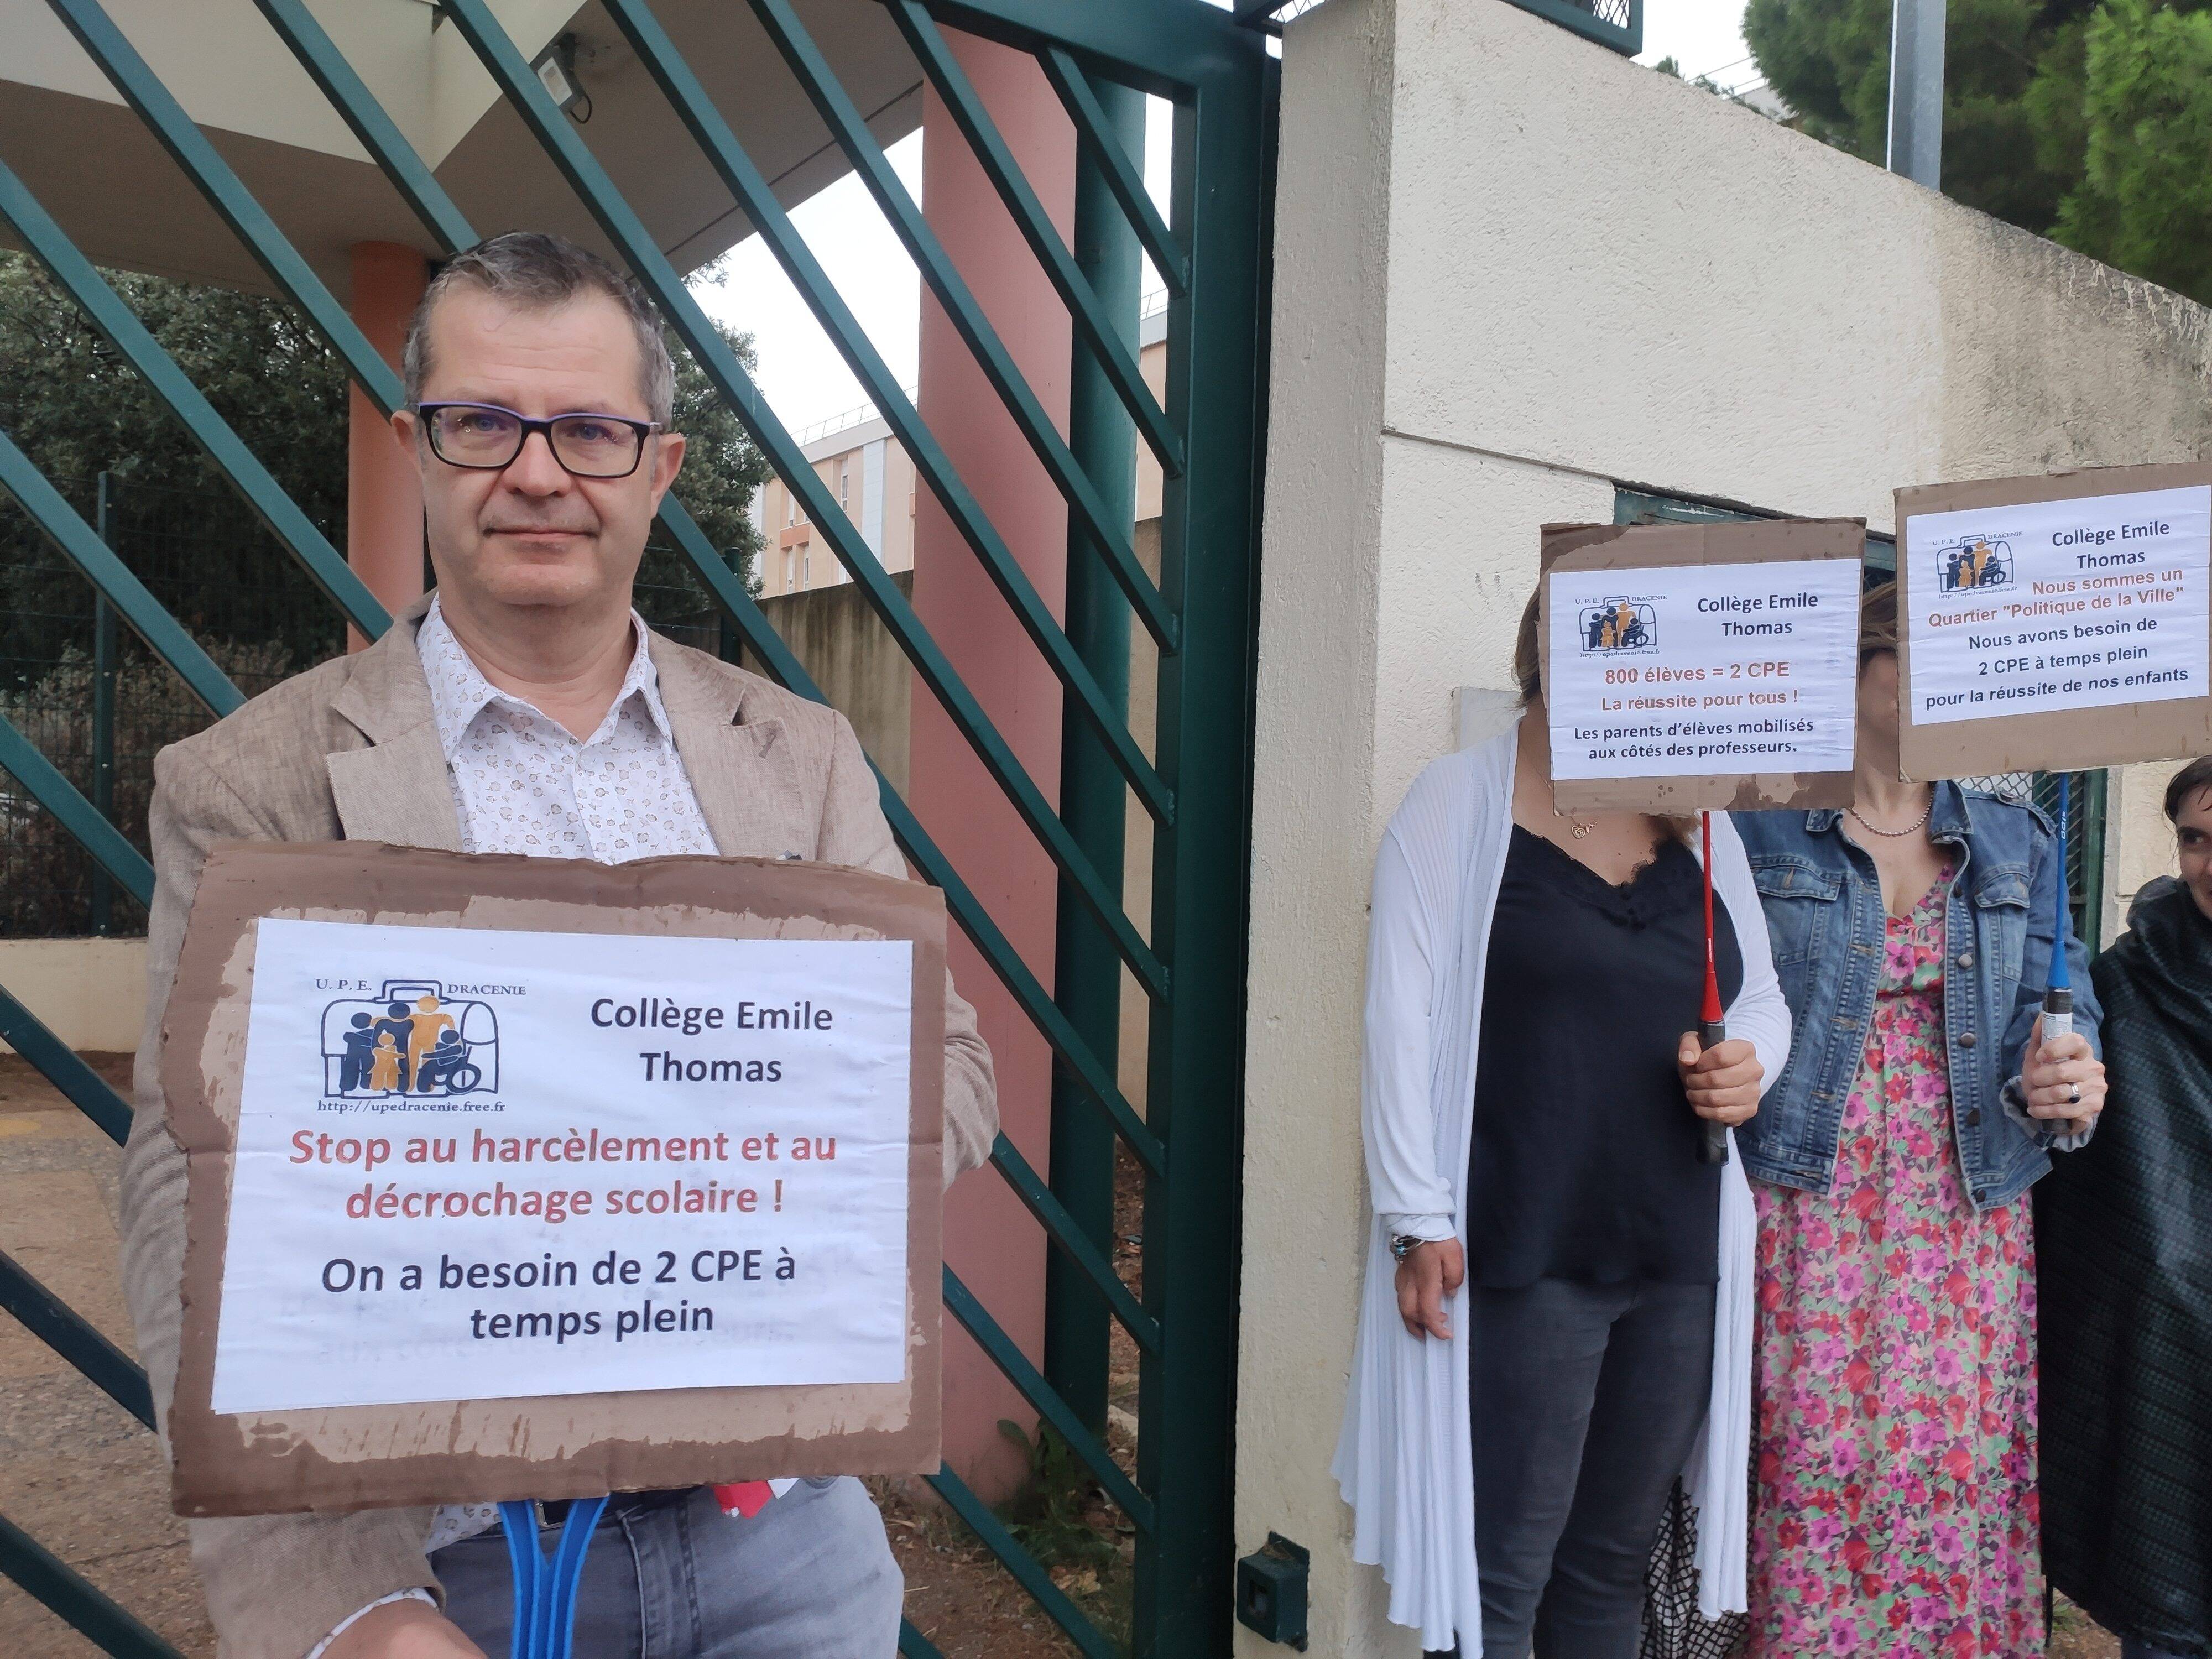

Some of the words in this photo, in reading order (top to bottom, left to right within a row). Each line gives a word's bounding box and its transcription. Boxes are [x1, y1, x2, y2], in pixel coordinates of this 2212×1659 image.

[2052, 528, 2116, 546] Collège
[2121, 520, 2169, 539] Emile
[2076, 552, 2146, 569] Thomas
[2033, 581, 2076, 596] Nous
[2082, 573, 2156, 591] sommes
[2161, 570, 2183, 582] un
[1698, 596, 1763, 614] Collège
[1769, 592, 1818, 609] Emile
[1928, 608, 1998, 627] Quartier
[2003, 600, 2086, 618] "Politique
[2091, 594, 2112, 609] de
[2117, 593, 2132, 607] la
[2137, 586, 2184, 604] Ville"
[1721, 621, 1792, 637] Thomas
[1969, 635, 2012, 650] Nous
[2018, 629, 2068, 644] avons
[2074, 620, 2131, 638] besoin
[2137, 617, 2157, 632] de
[1605, 667, 1639, 684] 800
[1645, 666, 1706, 682] élèves
[1712, 667, 1724, 676] =
[1730, 664, 1741, 679] 2
[1747, 661, 1790, 678] CPE
[1979, 662, 1988, 676] 2
[1994, 657, 2030, 674] CPE
[2035, 655, 2044, 669] à
[2049, 653, 2101, 668] temps
[2107, 645, 2148, 665] plein
[1602, 697, 1622, 711] La
[1628, 694, 1697, 710] réussite
[1703, 695, 1744, 710] pour
[1748, 692, 1787, 705] tous
[1794, 689, 1798, 703] !
[1926, 693, 1965, 711] pour
[1970, 690, 1984, 703] la
[1990, 682, 2057, 701] réussite
[2063, 679, 2083, 692] de
[2088, 677, 2119, 690] nos
[2125, 668, 2189, 686] enfants
[1575, 727, 1599, 740] Les
[1604, 726, 1663, 742] parents
[1738, 717, 1814, 734] mobilisés
[1589, 749, 1616, 759] aux
[1621, 743, 1662, 758] côtés
[1666, 743, 1694, 756] des
[1699, 740, 1797, 758] professeurs.
[448, 984, 526, 995] DRACENIE
[591, 997, 724, 1036] Collège
[737, 1000, 832, 1031] Emile
[639, 1050, 781, 1082] Thomas
[317, 1100, 506, 1115] http://upedracenie.free.fr
[289, 1130, 391, 1172] Stop
[405, 1138, 457, 1164] au
[472, 1128, 729, 1163] harcèlement
[741, 1132, 779, 1161] et
[790, 1137, 837, 1161] au
[346, 1181, 593, 1224] décrochage
[606, 1180, 758, 1215] scolaire
[774, 1179, 783, 1213] !
[322, 1258, 383, 1293] On
[399, 1265, 422, 1291] a
[439, 1253, 577, 1290] besoin
[592, 1250, 641, 1286] de
[654, 1251, 677, 1284] 2
[691, 1249, 763, 1282] CPE
[775, 1246, 795, 1280] à
[470, 1309, 601, 1345] temps
[615, 1299, 713, 1342] plein
